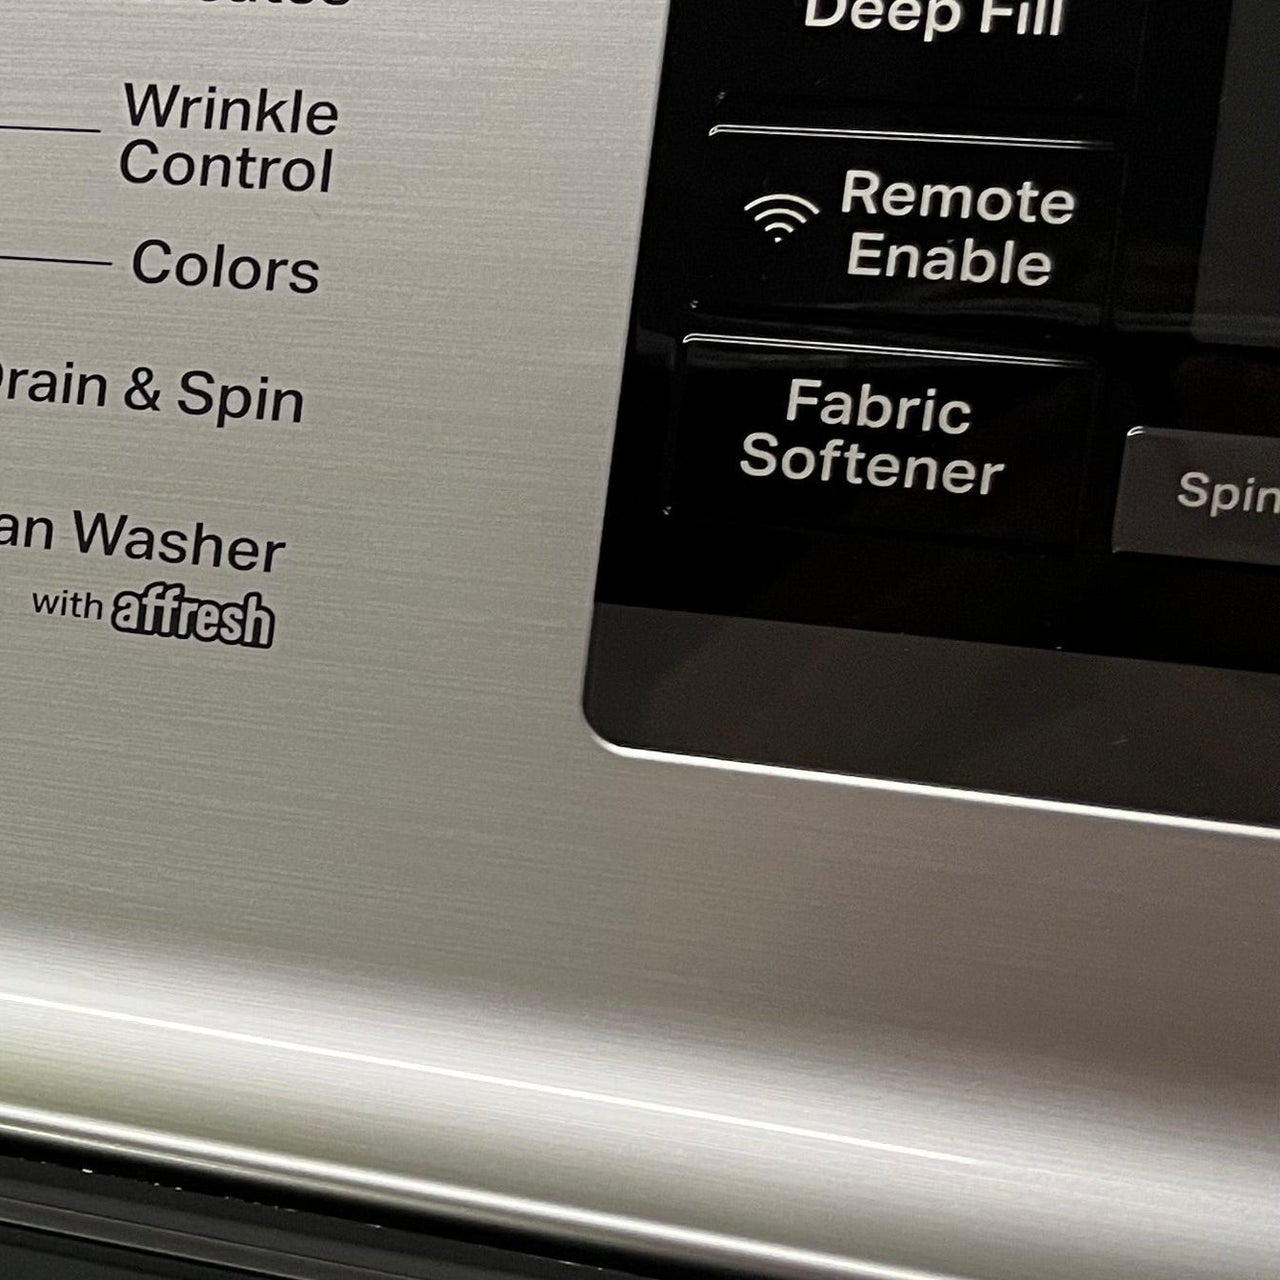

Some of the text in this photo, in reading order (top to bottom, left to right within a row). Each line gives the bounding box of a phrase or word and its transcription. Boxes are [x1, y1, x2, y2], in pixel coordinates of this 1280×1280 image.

[123, 81, 340, 137] Wrinkle
[119, 138, 334, 194] Control
[840, 168, 1077, 227] Remote
[132, 238, 320, 295] Colors
[846, 231, 1055, 288] Enable
[123, 366, 162, 413] &
[177, 369, 306, 429] Spin
[784, 377, 974, 437] Fabric
[739, 432, 1006, 497] Softener
[1177, 471, 1280, 518] Spin
[72, 508, 287, 573] Washer
[31, 580, 276, 650] with affresh
